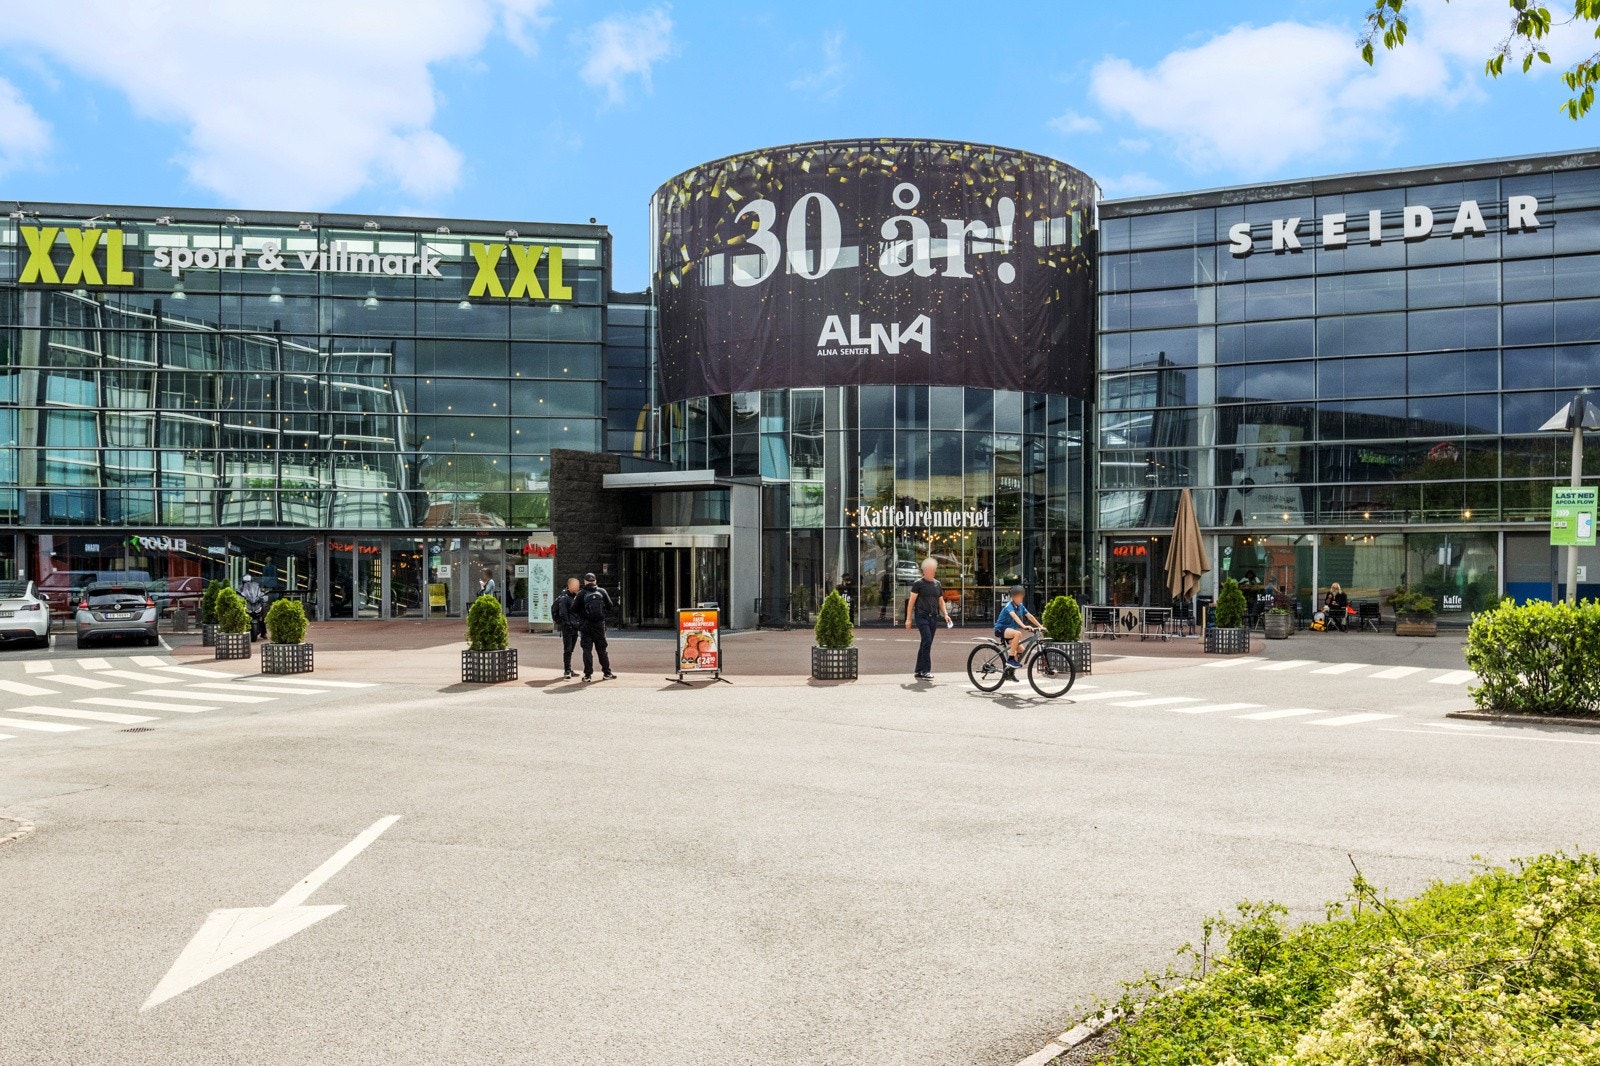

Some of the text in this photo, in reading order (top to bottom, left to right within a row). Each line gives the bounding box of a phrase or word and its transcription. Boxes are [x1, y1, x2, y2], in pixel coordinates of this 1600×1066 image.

[732, 182, 1017, 287] 30 år!
[1228, 195, 1541, 256] SKEIDAR
[18, 226, 134, 286] XXL
[153, 240, 443, 277] sport & villmark
[467, 242, 573, 301] XXL
[816, 313, 932, 355] ALNA
[840, 348, 869, 356] SENTER
[858, 505, 990, 528] Kaffebrenneriet
[1443, 595, 1462, 604] Kaffe
